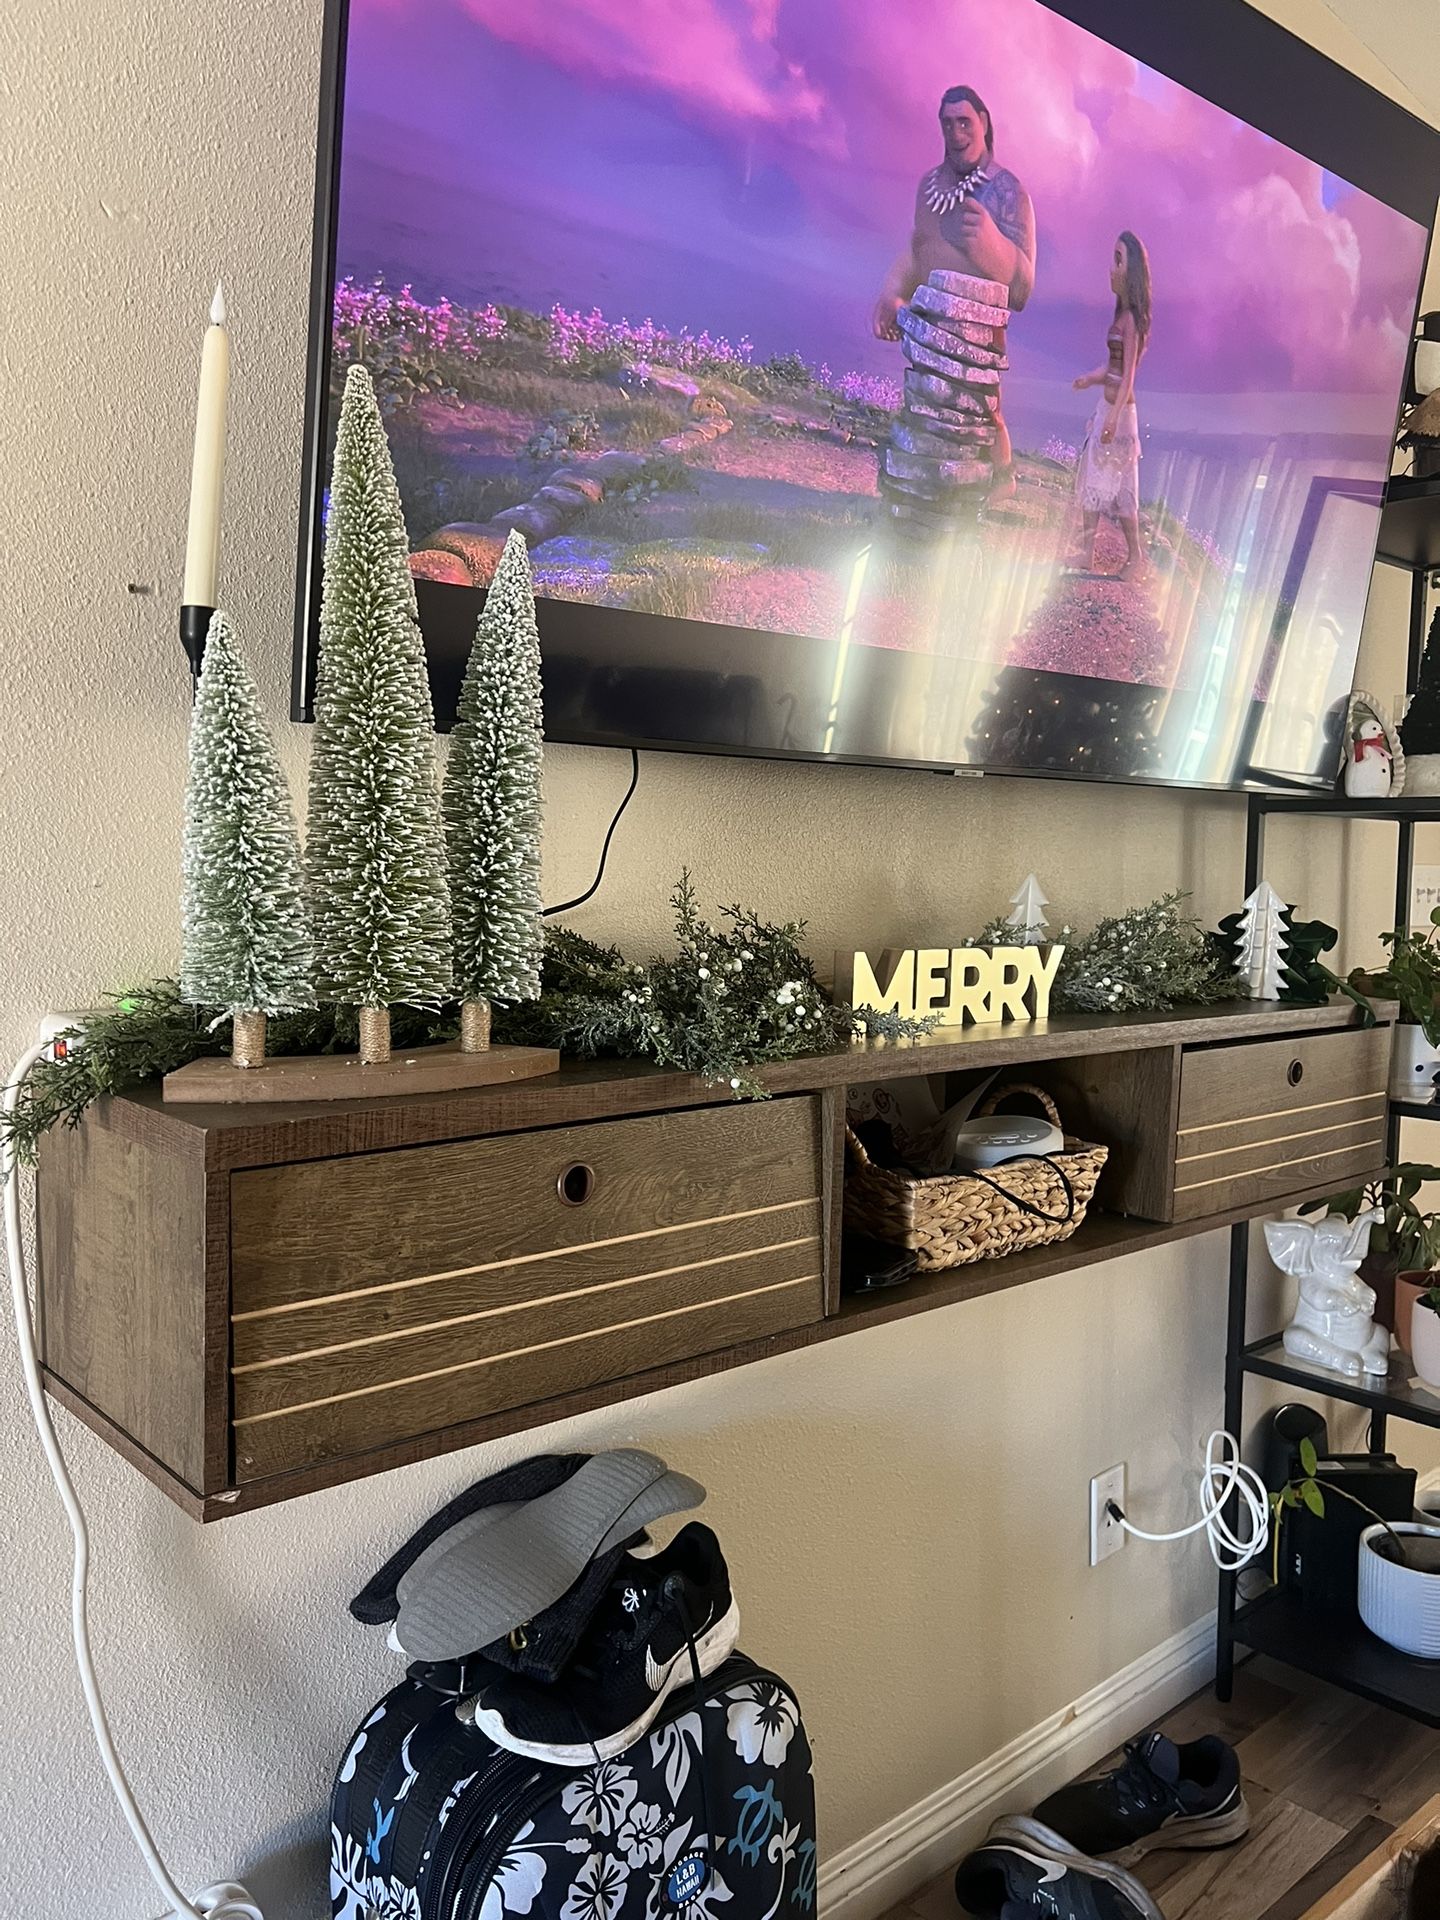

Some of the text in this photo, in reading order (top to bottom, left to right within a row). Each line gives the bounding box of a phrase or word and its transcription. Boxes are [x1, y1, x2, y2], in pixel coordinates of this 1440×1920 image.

[851, 945, 1066, 1034] MERRY
[668, 1852, 704, 1877] LUGGAGE
[676, 1863, 696, 1885] L&B
[676, 1874, 700, 1899] HAWAII
